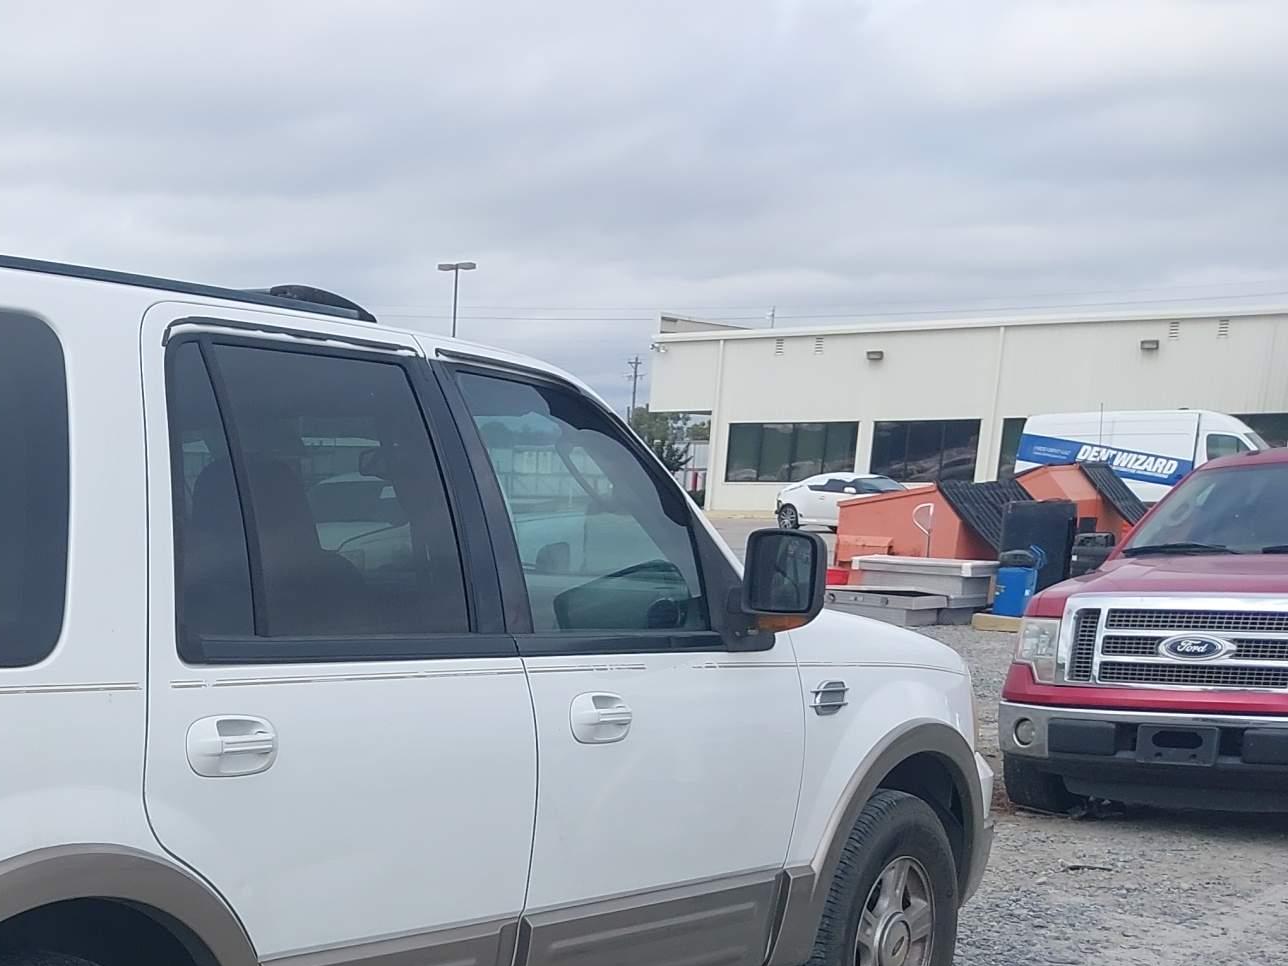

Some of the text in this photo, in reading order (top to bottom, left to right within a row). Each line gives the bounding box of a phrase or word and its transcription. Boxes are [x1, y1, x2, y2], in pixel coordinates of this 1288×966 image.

[1075, 444, 1117, 463] DENT
[1113, 450, 1178, 475] WIZARD
[1177, 640, 1209, 653] Ford
